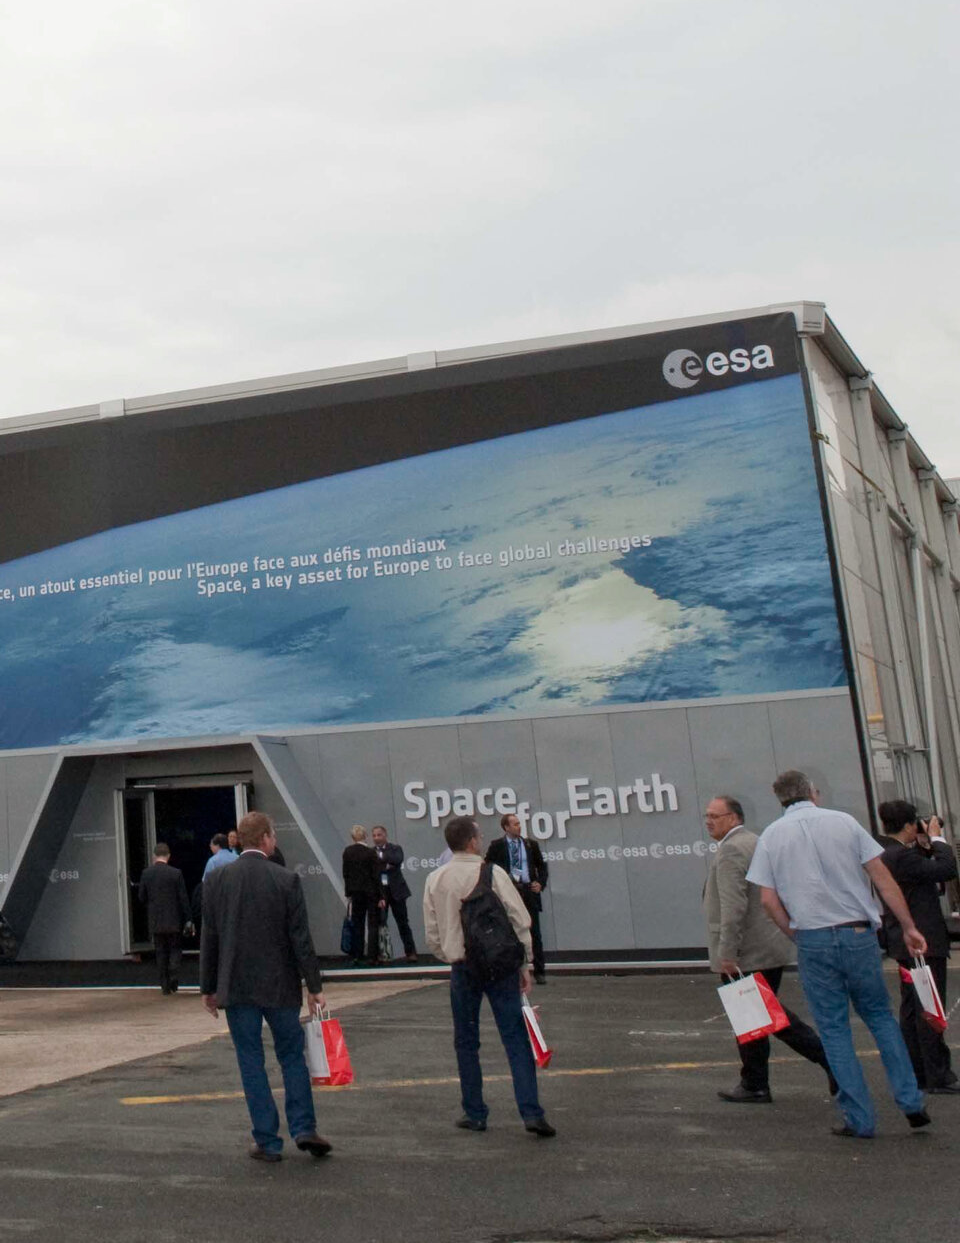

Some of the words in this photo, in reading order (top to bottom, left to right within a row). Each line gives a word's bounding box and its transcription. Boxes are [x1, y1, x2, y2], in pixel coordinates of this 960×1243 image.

[706, 344, 774, 376] esa
[19, 585, 36, 597] un
[40, 577, 76, 595] atout
[79, 568, 143, 590] essentiel
[148, 567, 182, 586] pour
[187, 560, 248, 579] l'Europe
[253, 556, 285, 572] face
[290, 553, 319, 568] aux
[323, 545, 361, 564] défis
[366, 538, 447, 560] mondiaux
[197, 578, 247, 598] Space,
[251, 577, 261, 590] a
[265, 572, 293, 590] key
[298, 566, 343, 585] asset
[346, 563, 369, 580] for
[373, 559, 430, 578] Europe
[435, 555, 453, 570] to
[458, 550, 492, 568] face
[498, 541, 552, 567] global
[557, 533, 652, 557] challenges
[403, 780, 518, 828] Space
[516, 802, 572, 840] for
[566, 773, 679, 817] Earth
[581, 847, 606, 860] esa
[623, 846, 648, 857] esa
[666, 842, 691, 855] esa
